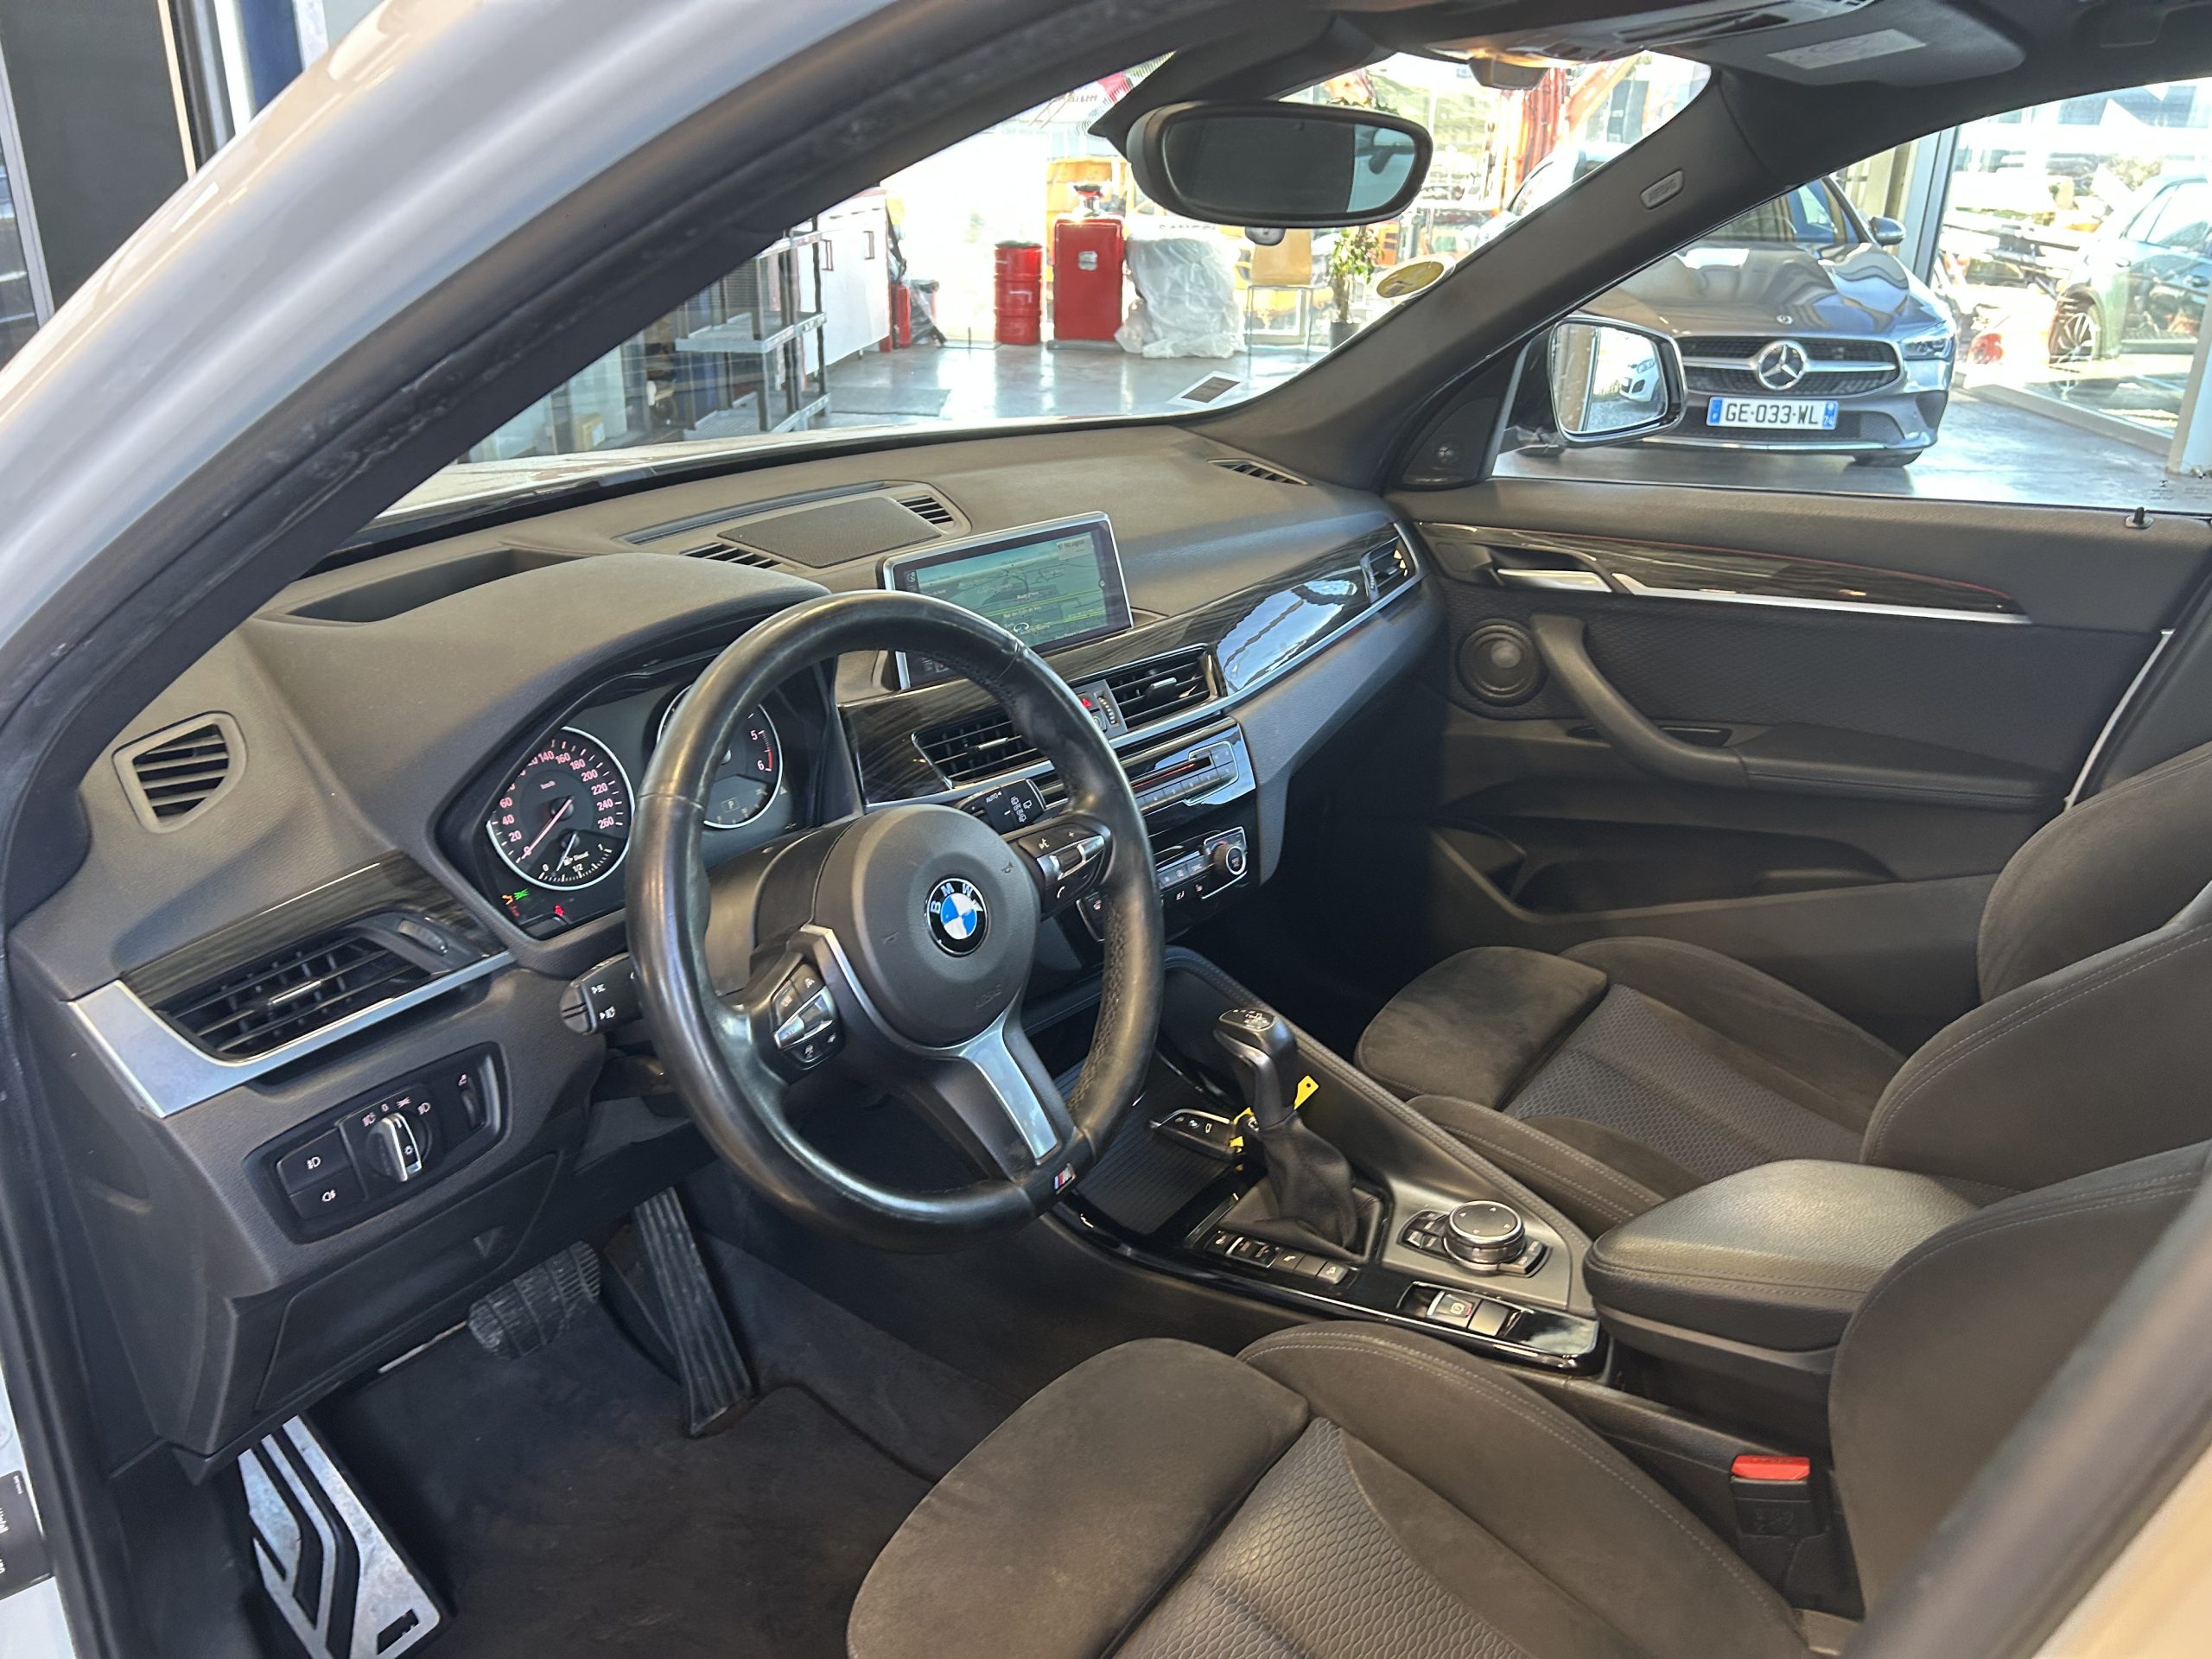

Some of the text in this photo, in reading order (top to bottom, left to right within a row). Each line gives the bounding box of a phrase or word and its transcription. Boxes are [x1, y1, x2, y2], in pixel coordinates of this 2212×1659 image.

[1725, 403, 1819, 425] GE-033-WL
[750, 729, 758, 741] 5
[537, 750, 555, 763] 140
[555, 752, 571, 765] 160
[569, 758, 586, 771] 180
[757, 760, 765, 771] 6
[581, 769, 599, 782] 200
[591, 782, 608, 796] 220
[499, 797, 512, 809] 60
[596, 798, 614, 811] 240
[985, 793, 999, 804] AUTO
[502, 814, 515, 826] 40
[598, 817, 615, 830] 260
[508, 830, 523, 842] 20
[542, 862, 550, 873] 0
[931, 881, 974, 914] BMW
